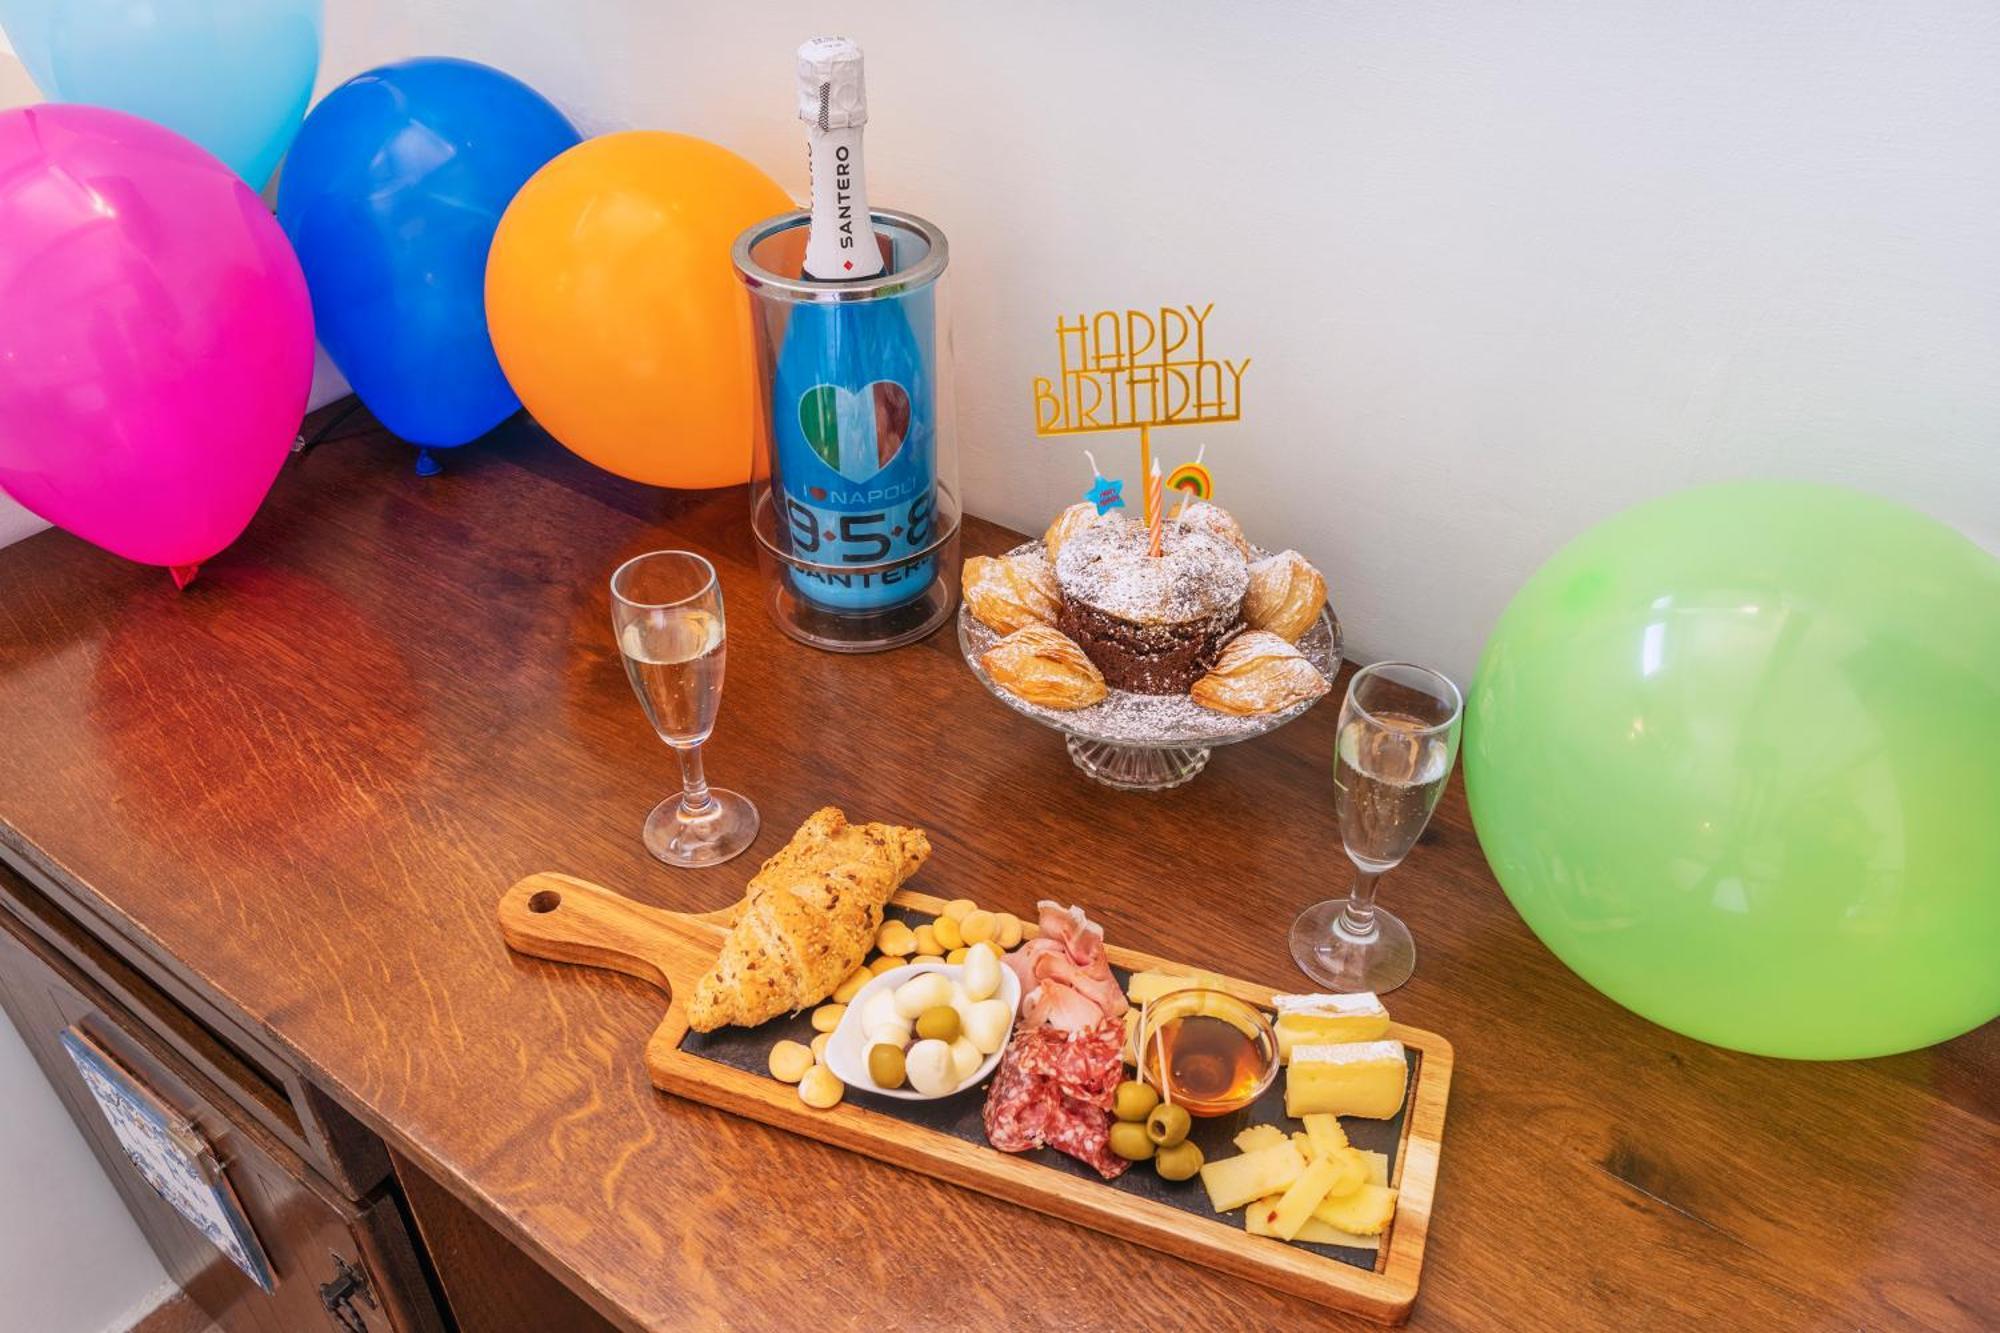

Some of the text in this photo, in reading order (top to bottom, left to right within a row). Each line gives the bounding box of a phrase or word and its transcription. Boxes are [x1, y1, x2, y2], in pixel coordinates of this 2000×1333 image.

[835, 145, 854, 249] SANTERO
[1056, 303, 1214, 372] HAPPY
[1033, 358, 1251, 437] BIRTHDAY
[830, 476, 917, 505] NAPOLI
